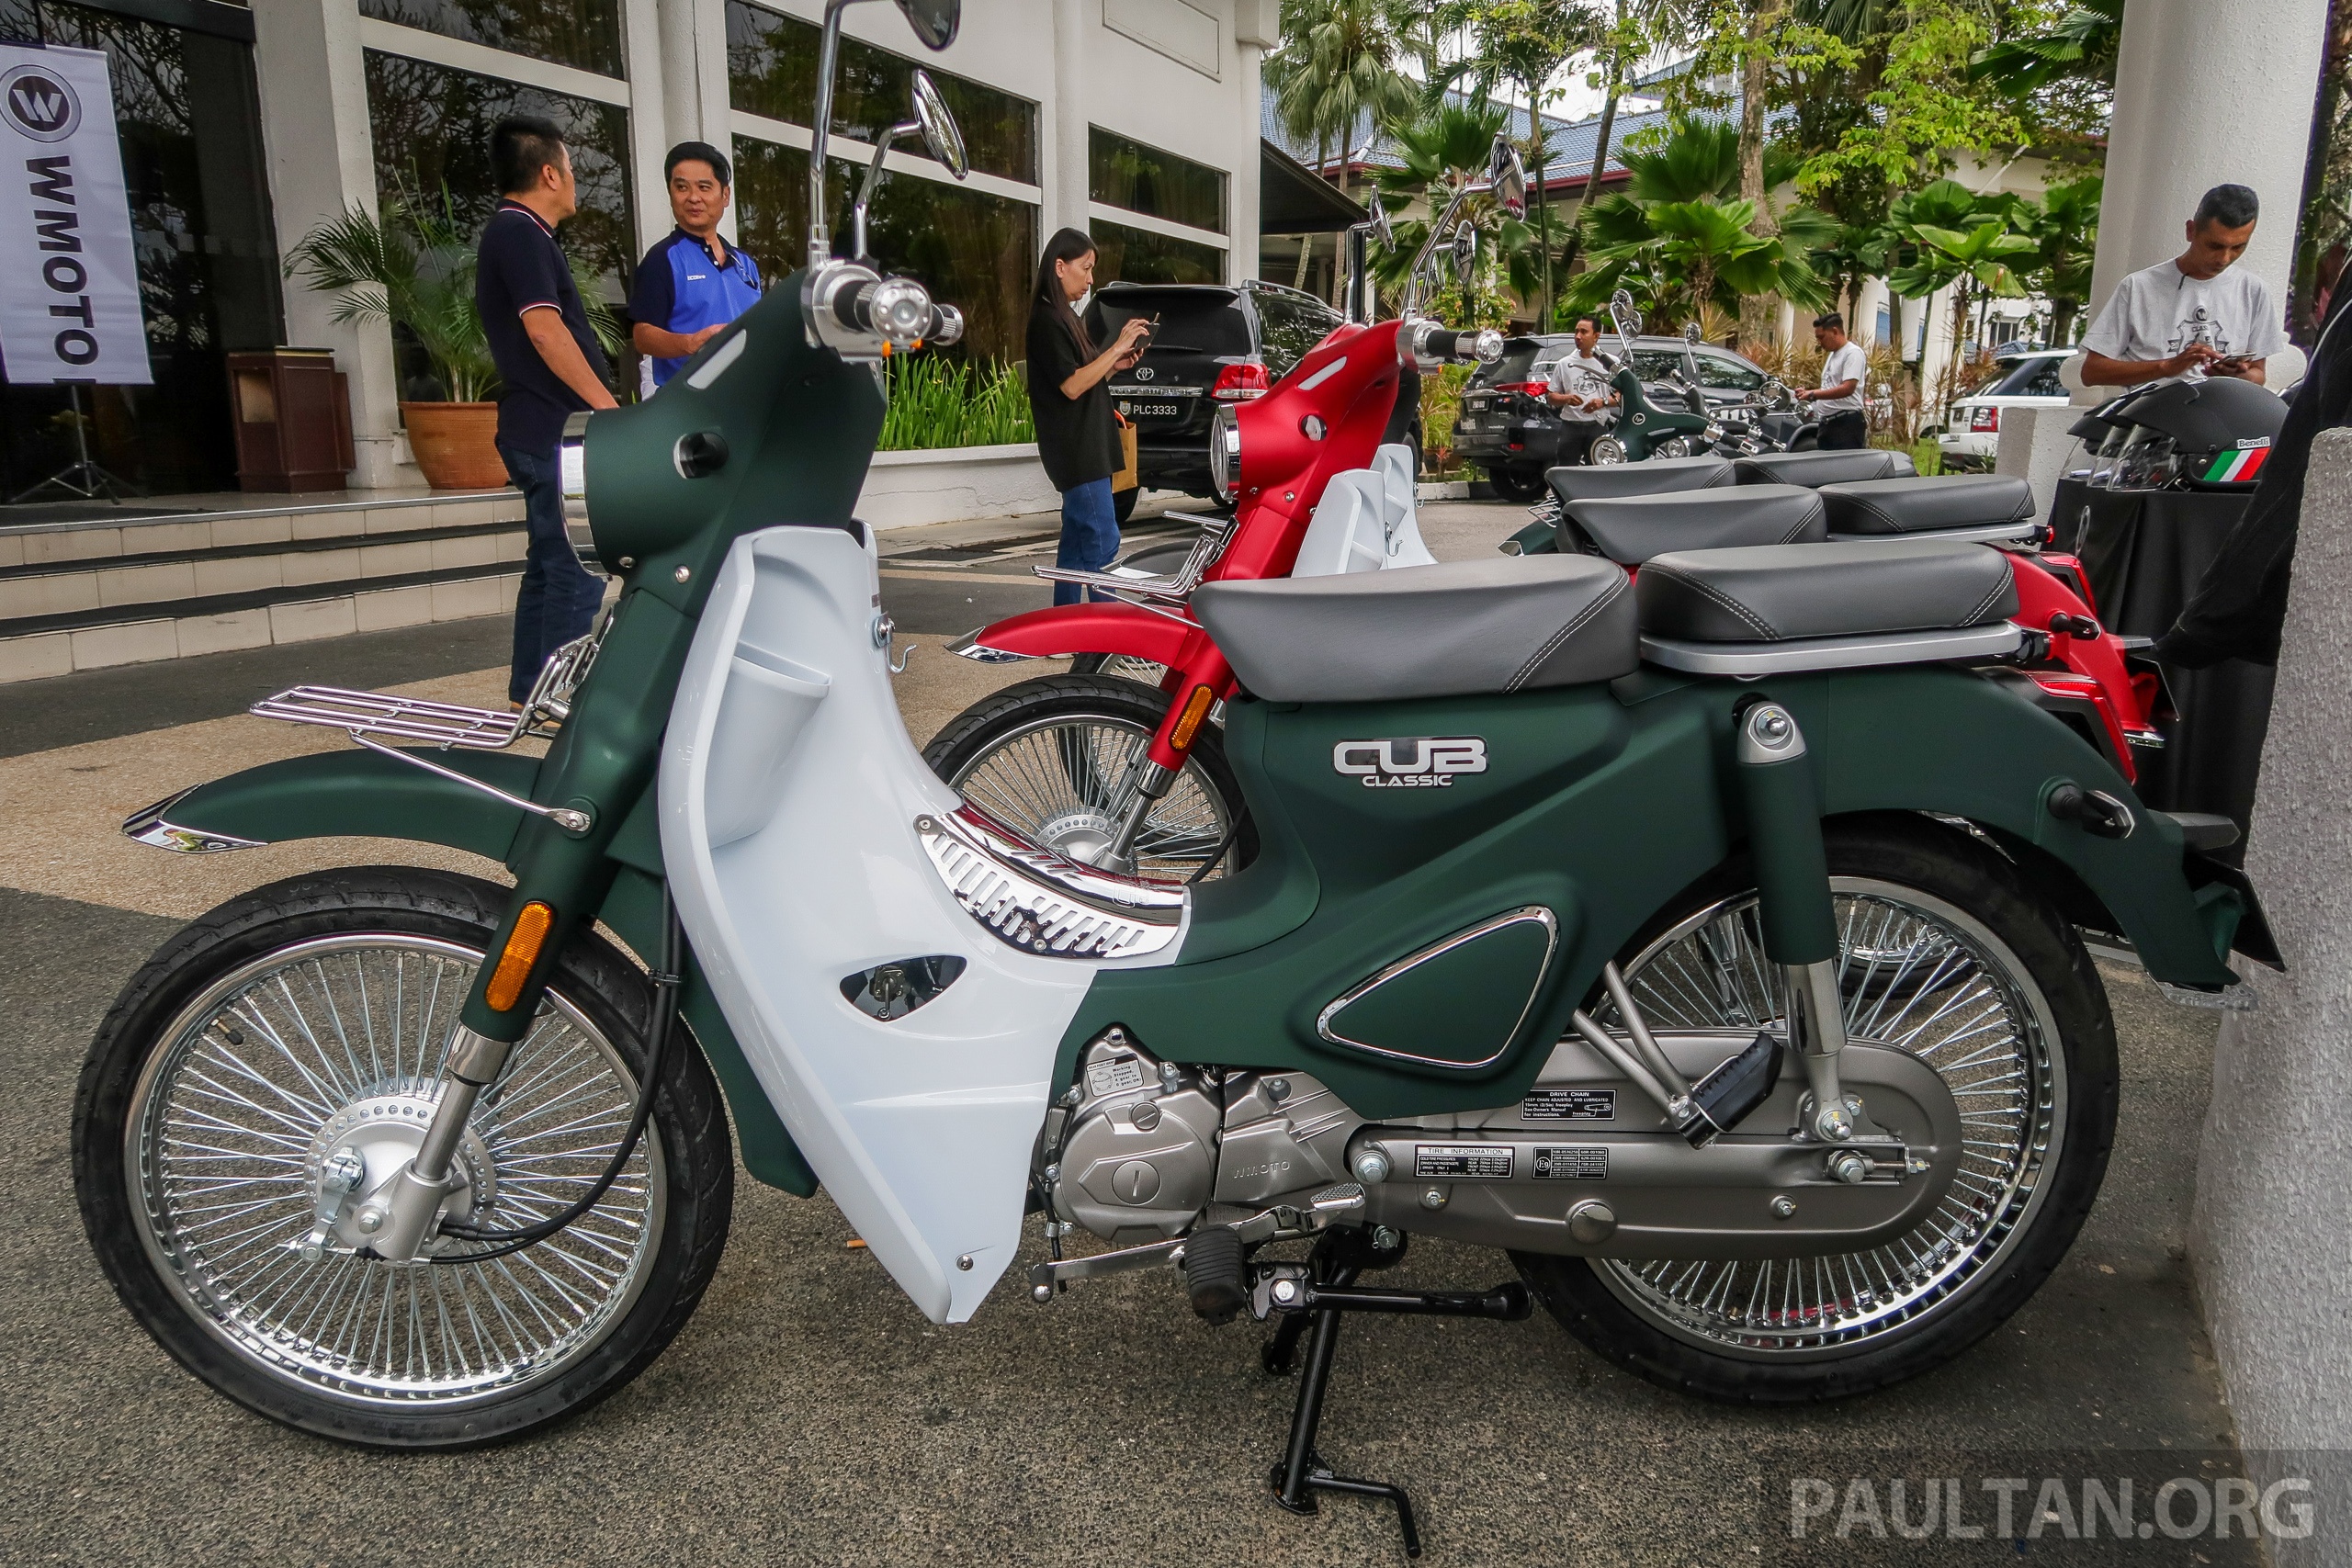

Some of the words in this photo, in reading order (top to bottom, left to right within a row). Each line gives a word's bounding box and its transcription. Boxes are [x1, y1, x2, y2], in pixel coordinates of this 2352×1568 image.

[26, 155, 99, 367] WMOTO
[1133, 404, 1177, 415] PLC3333
[1333, 739, 1487, 773] CUB
[1362, 774, 1453, 788] CLASSIC
